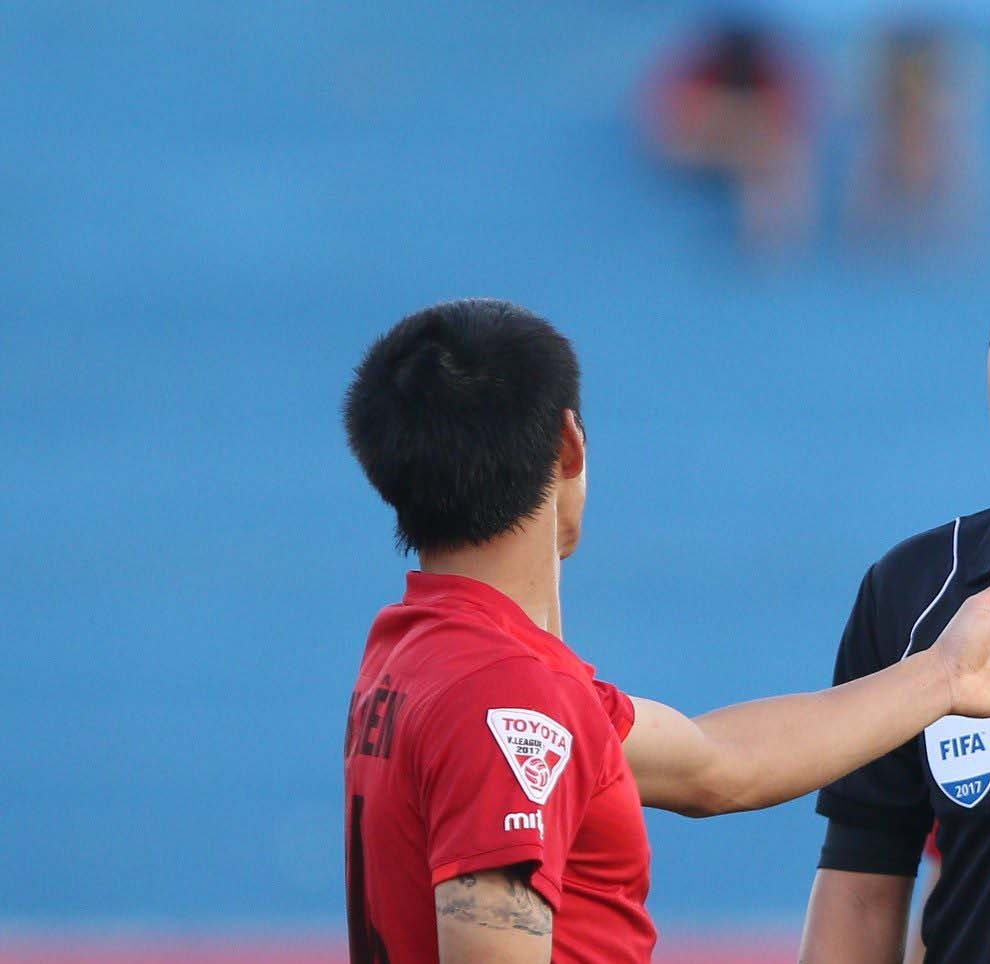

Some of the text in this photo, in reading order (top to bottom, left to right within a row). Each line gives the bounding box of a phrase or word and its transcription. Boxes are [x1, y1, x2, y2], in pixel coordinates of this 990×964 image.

[502, 717, 567, 751] TOYOTA
[939, 732, 986, 761] FIFA
[516, 745, 540, 755] 2017
[954, 780, 982, 798] 2017
[504, 809, 544, 841] mit
